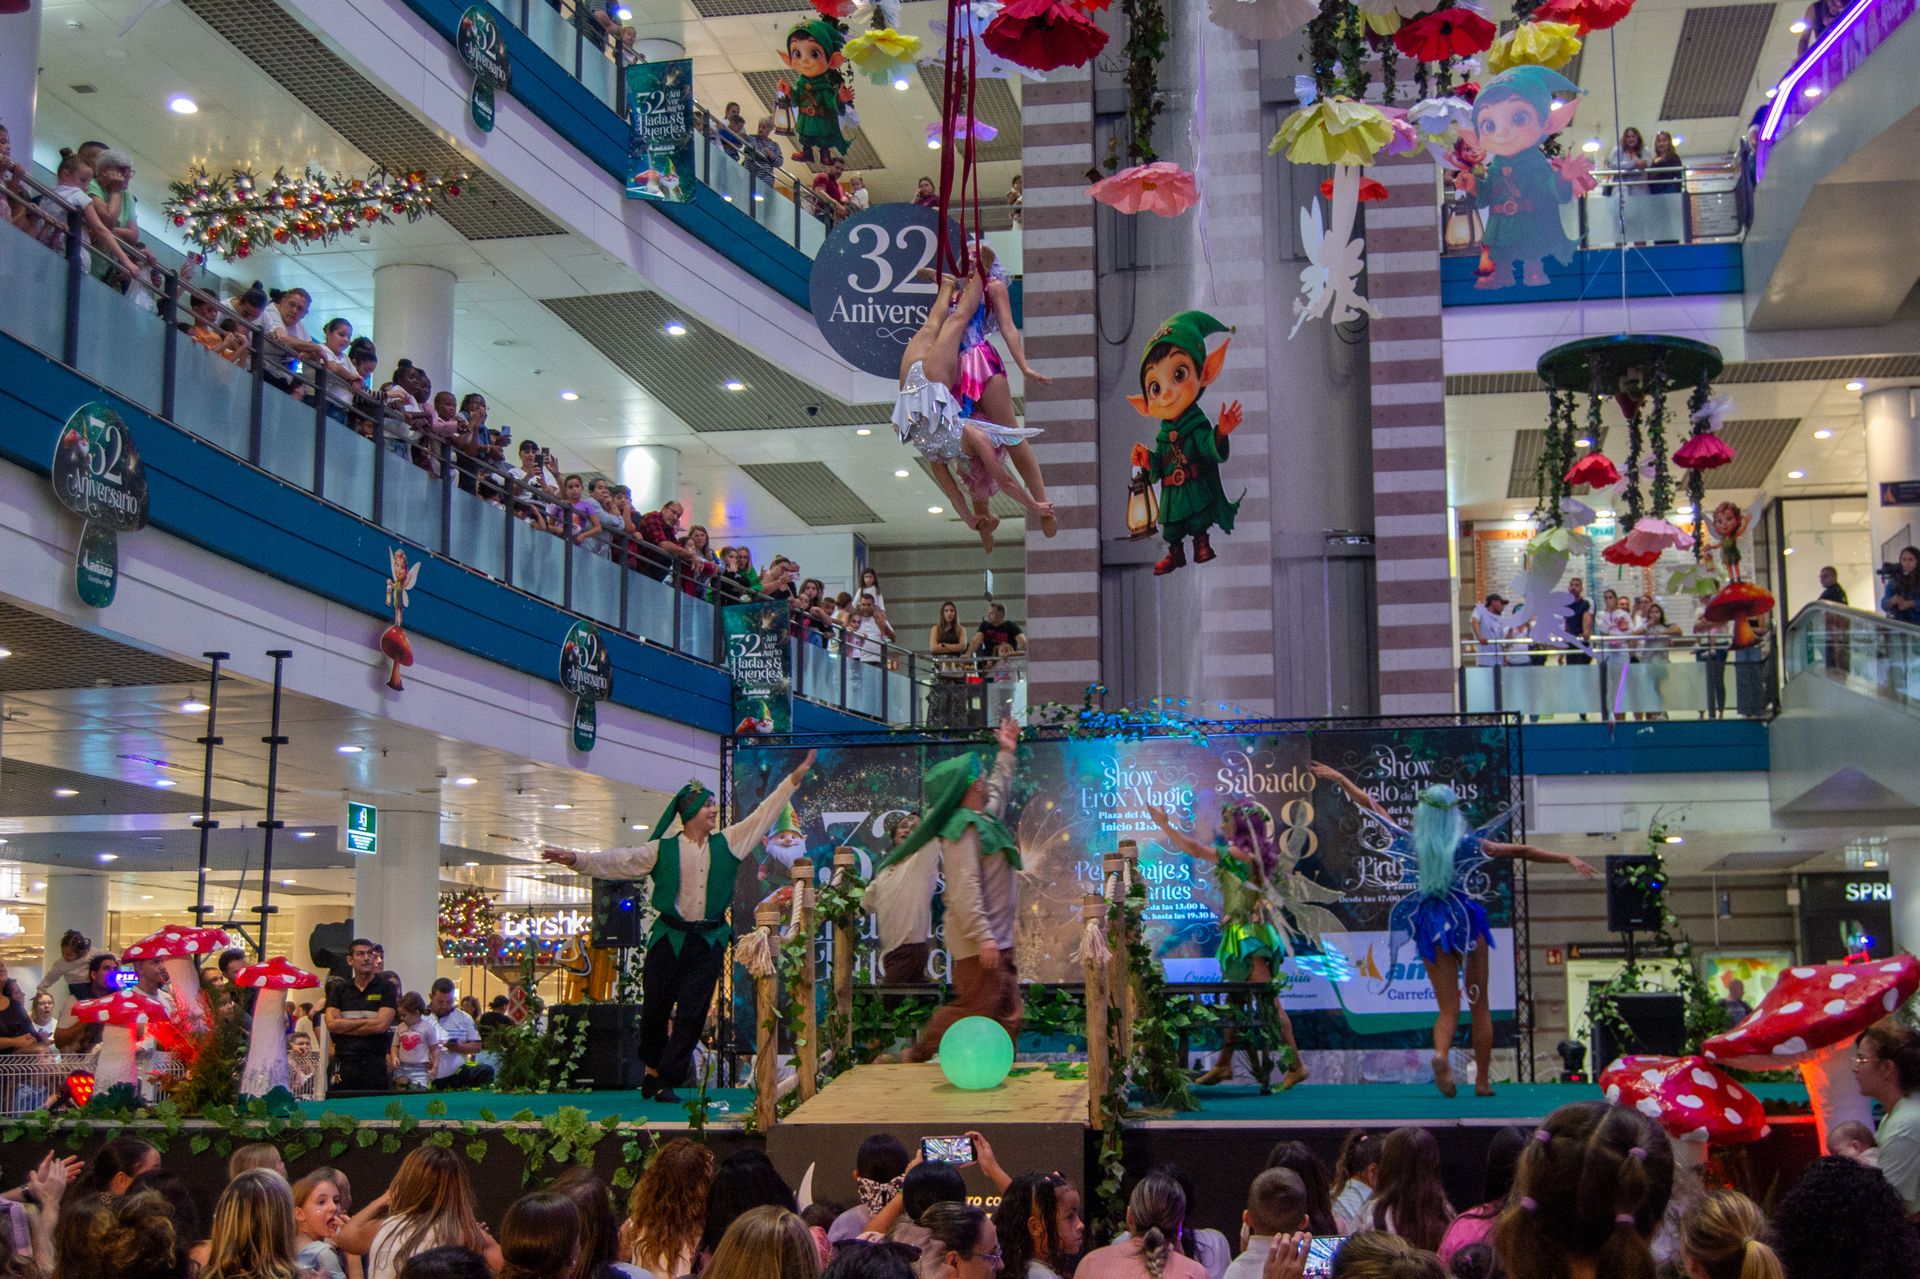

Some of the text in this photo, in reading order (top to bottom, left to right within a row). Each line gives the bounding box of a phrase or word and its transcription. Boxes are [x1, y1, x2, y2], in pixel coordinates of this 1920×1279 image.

[477, 12, 497, 60] 32
[636, 91, 665, 116] 32
[637, 112, 685, 126] Hadas &
[637, 124, 686, 140] Duendes
[847, 223, 939, 294] 32
[89, 416, 123, 485] 32
[66, 467, 138, 522] Aniversario
[579, 630, 599, 671] 32
[730, 633, 761, 657] 32
[731, 656, 782, 669] Hadas &
[731, 668, 783, 685] Duendes
[1101, 754, 1158, 790] Show
[1215, 751, 1316, 798] Sábado
[1371, 745, 1430, 780] Show
[1082, 785, 1194, 815] Erox Magic
[1099, 811, 1122, 819] Plaza
[1124, 811, 1138, 819] del
[1101, 822, 1132, 831] Inicio
[1845, 882, 1892, 901] SPRI
